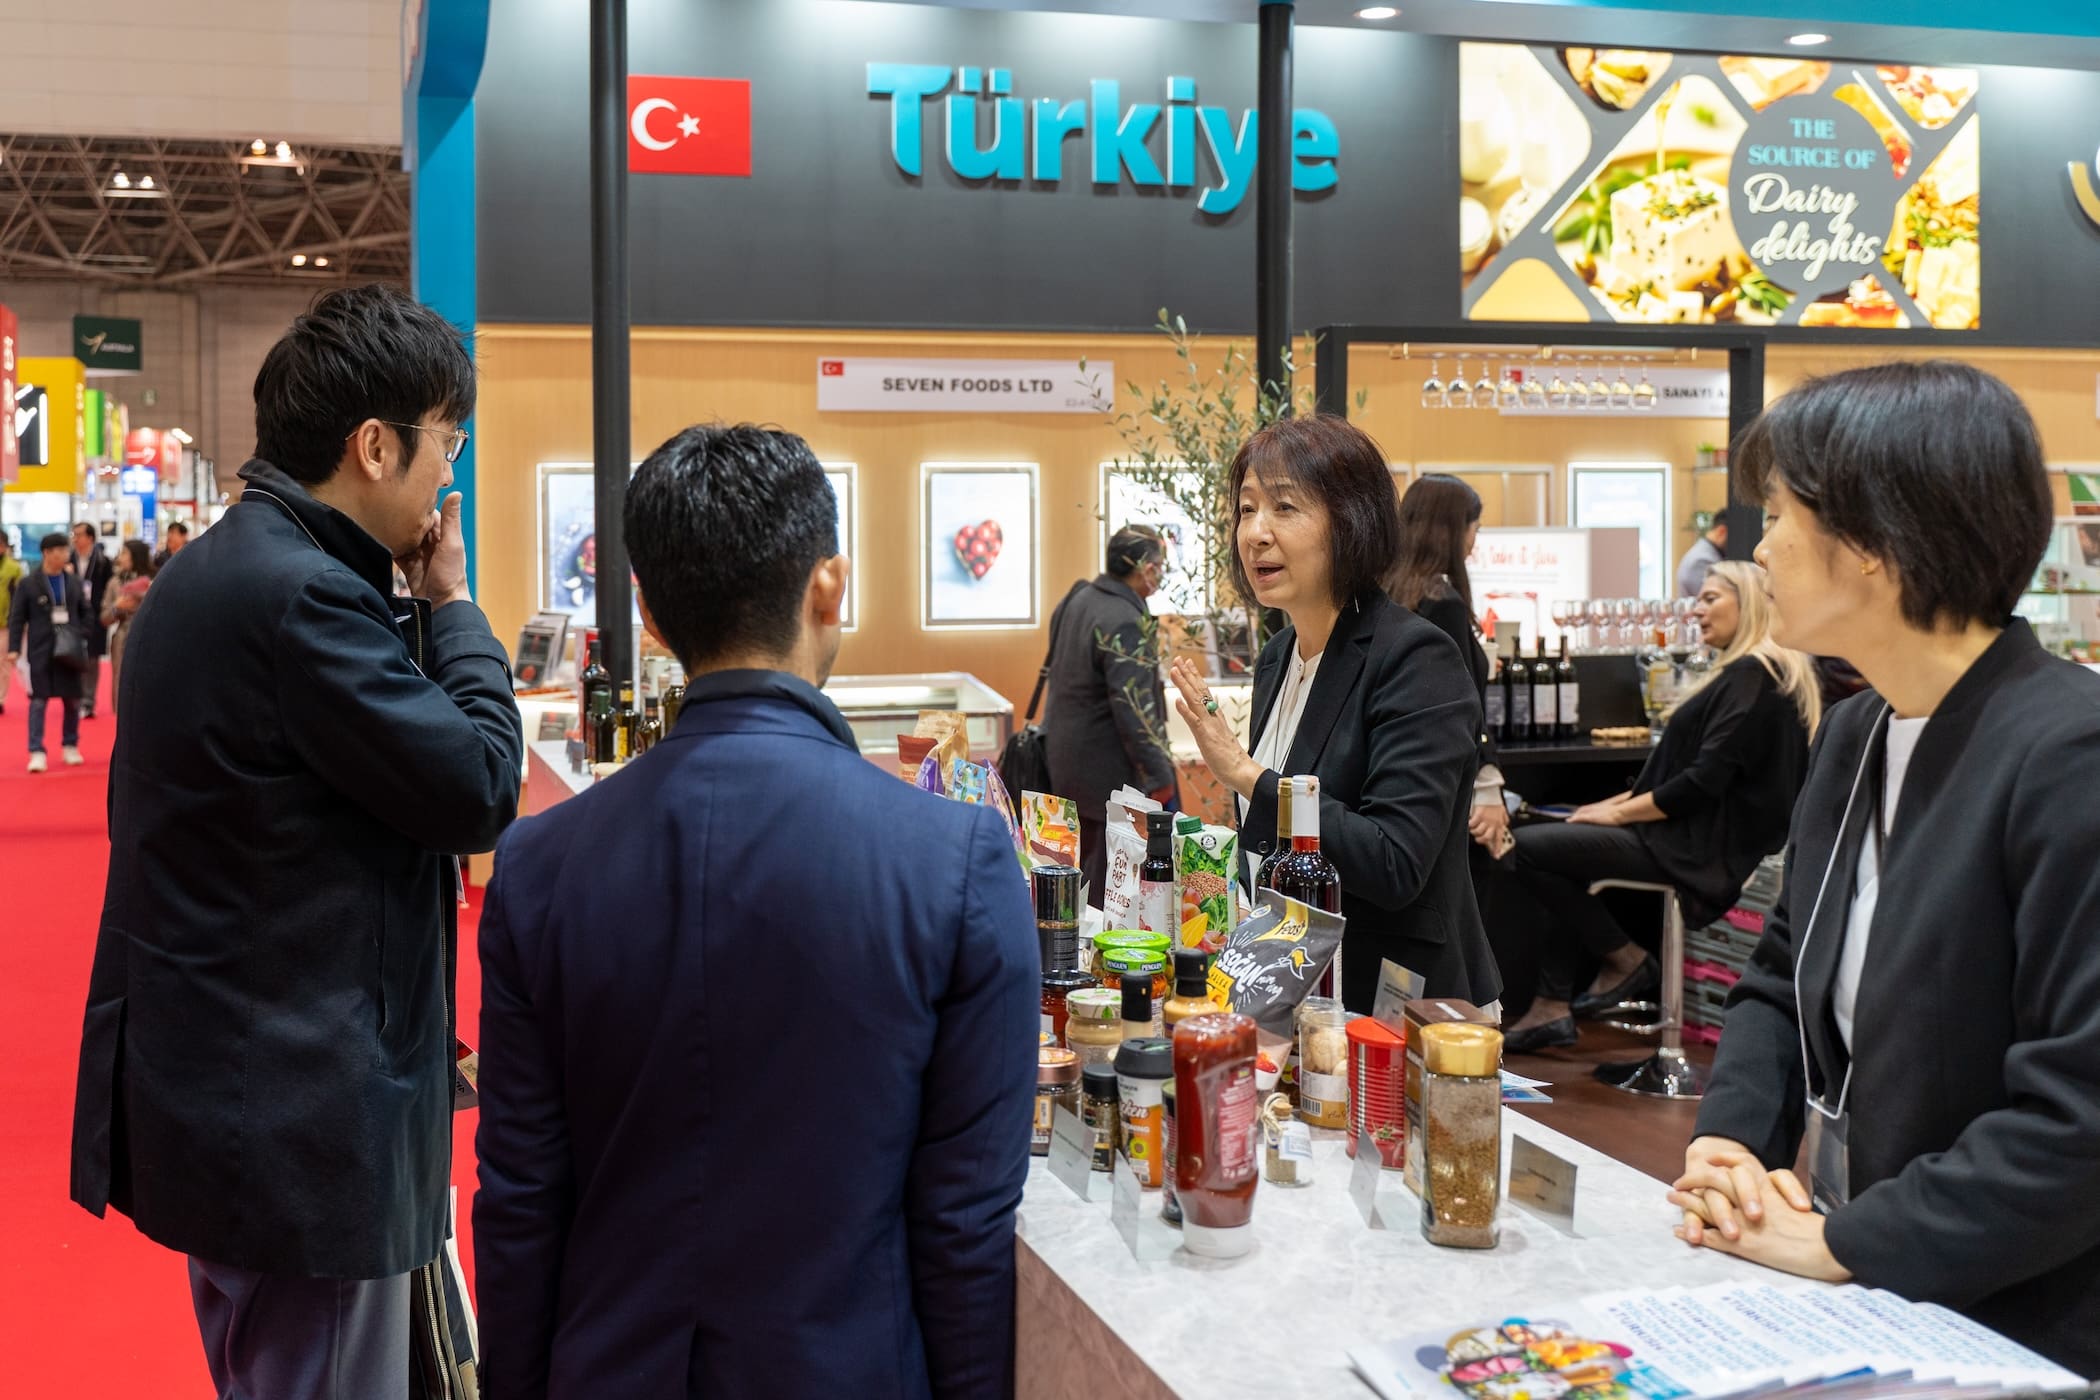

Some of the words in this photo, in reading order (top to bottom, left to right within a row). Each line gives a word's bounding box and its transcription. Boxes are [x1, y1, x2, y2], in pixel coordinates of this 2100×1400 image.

[866, 63, 1340, 214] Türkiye
[1789, 117, 1836, 140] THE
[1747, 143, 1841, 169] SOURCE
[1844, 147, 1877, 170] OF
[1743, 172, 1859, 234] Dairy
[1750, 220, 1882, 282] delights
[883, 377, 944, 392] SEVEN
[951, 378, 1012, 392] FOODS
[1019, 379, 1053, 393] LTD
